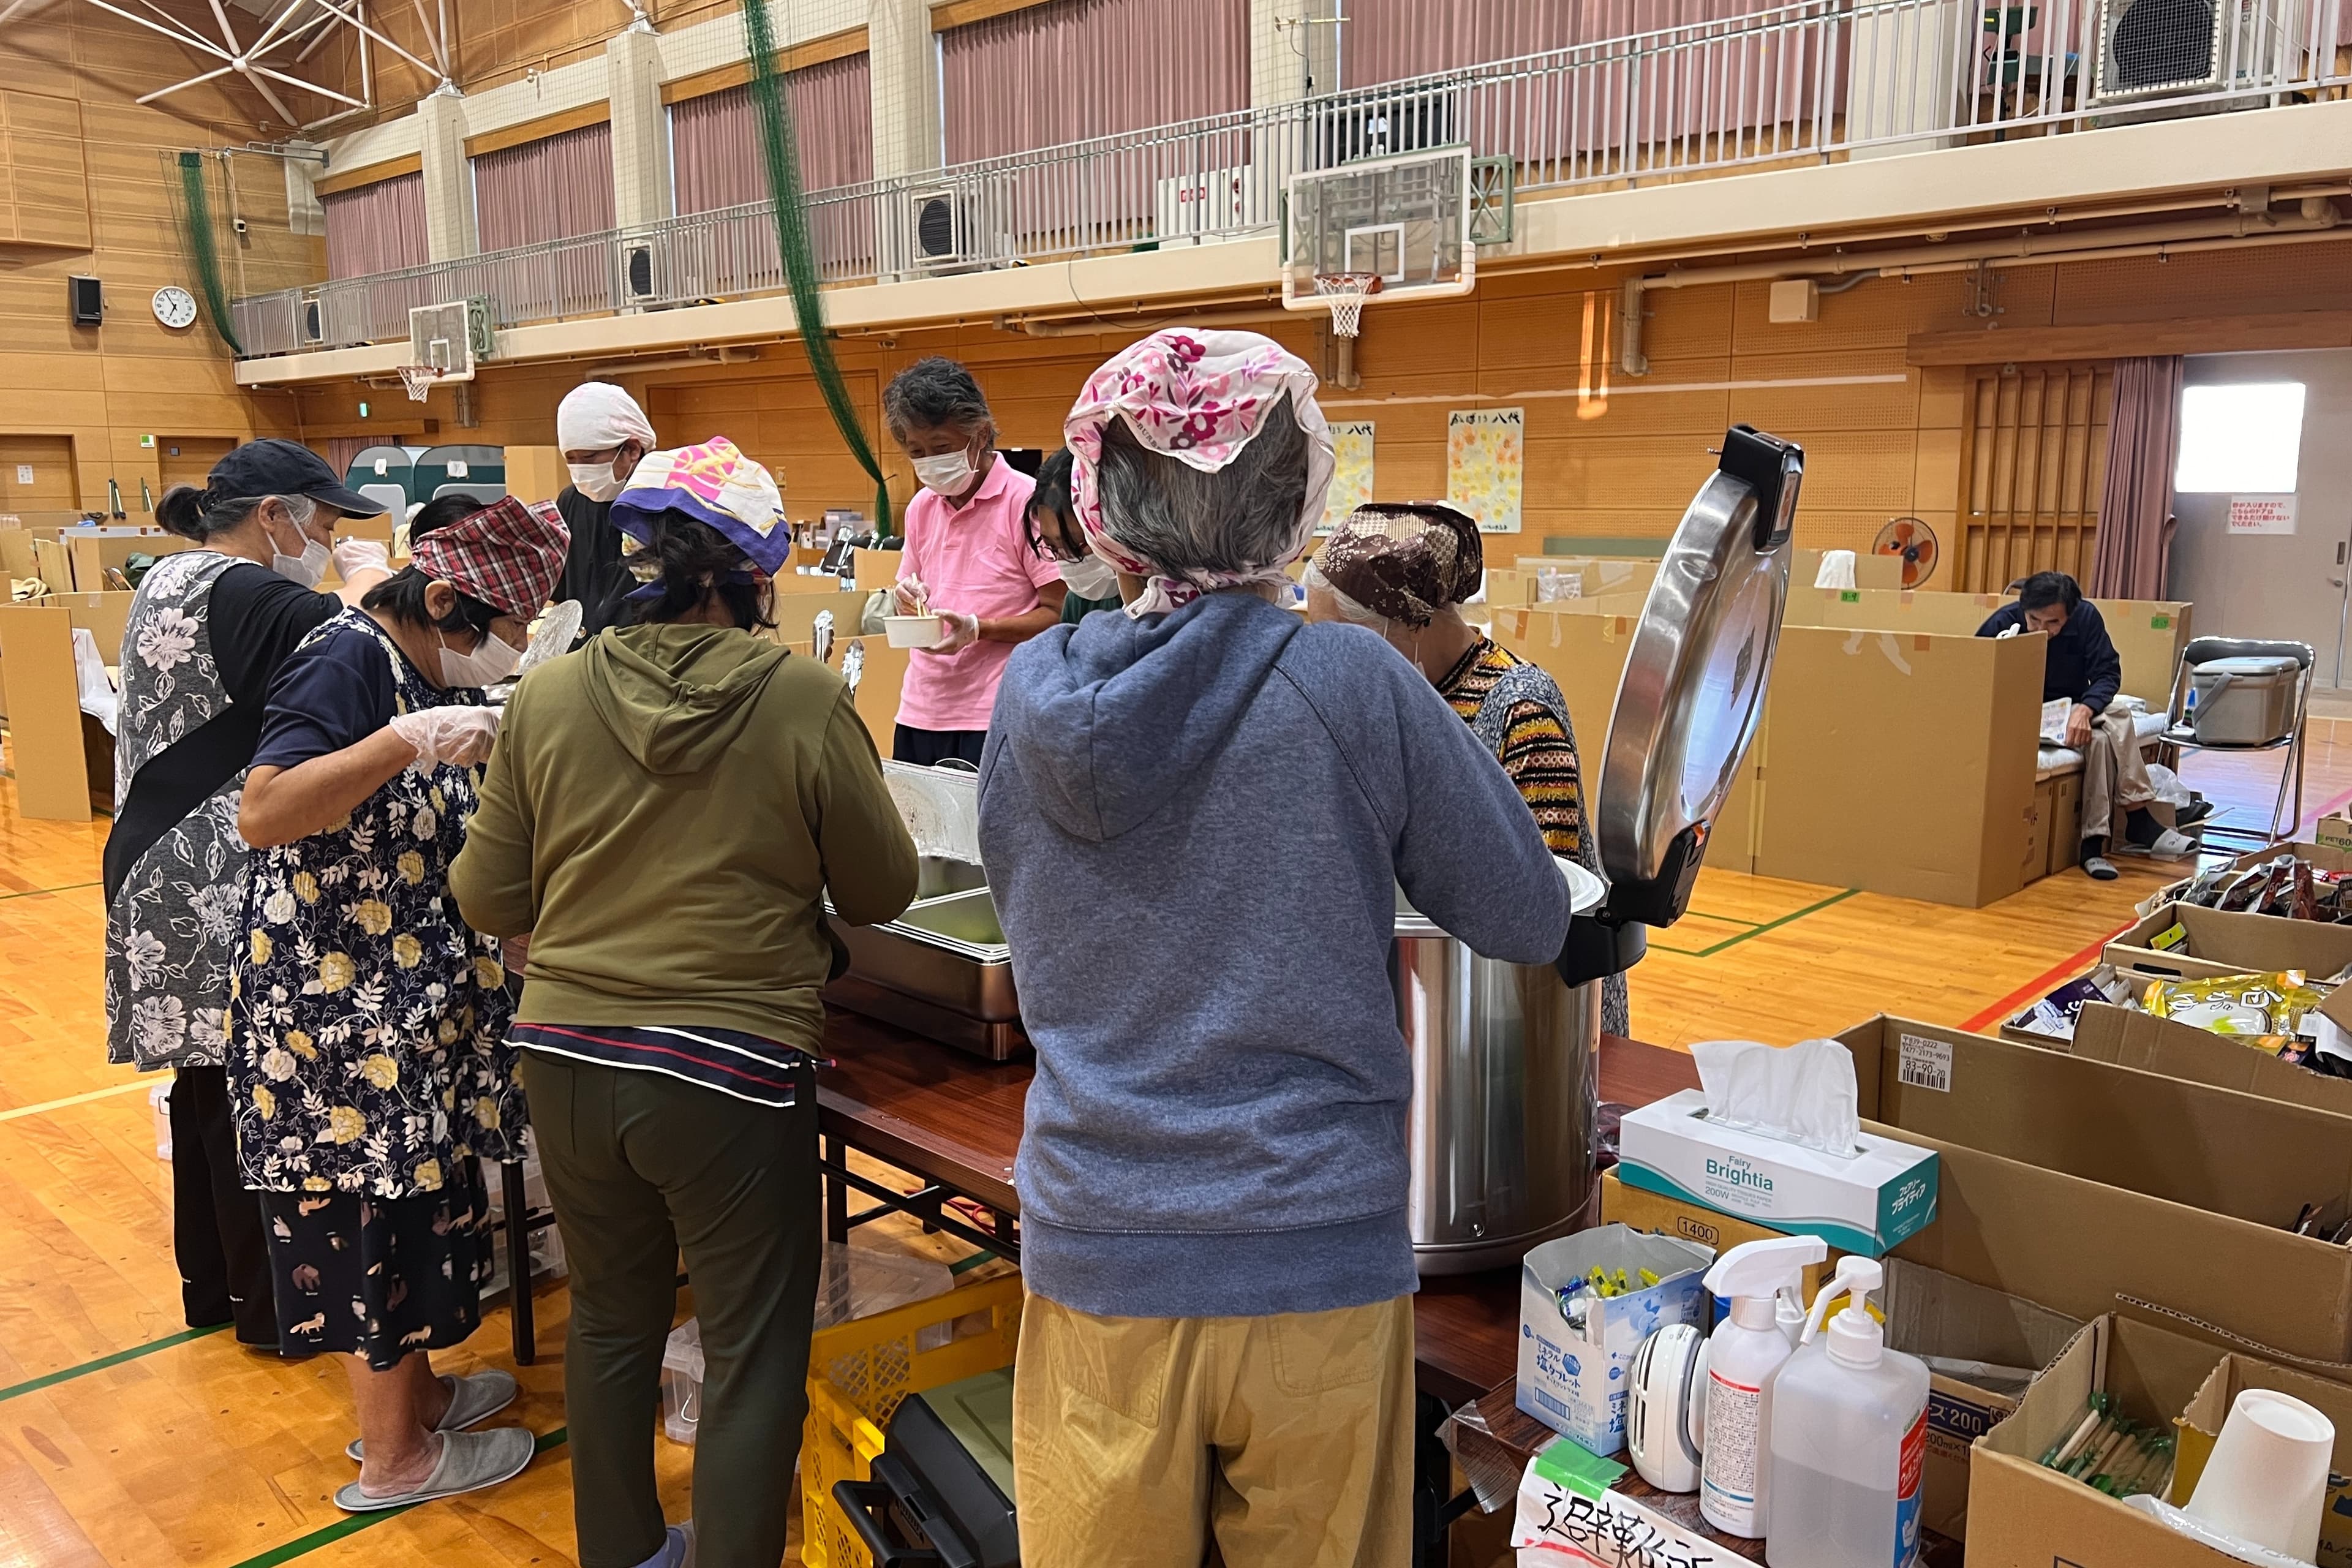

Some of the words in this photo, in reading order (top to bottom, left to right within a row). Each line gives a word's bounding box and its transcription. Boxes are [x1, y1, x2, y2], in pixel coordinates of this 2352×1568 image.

[1728, 1155, 1752, 1170] Fairy
[1706, 1158, 1773, 1191] Brightia
[1705, 1186, 1730, 1199] 200W
[1683, 1221, 1713, 1241] 1400
[1537, 1343, 1561, 1363] ミネラル
[1537, 1354, 1581, 1389] 塩タブレット
